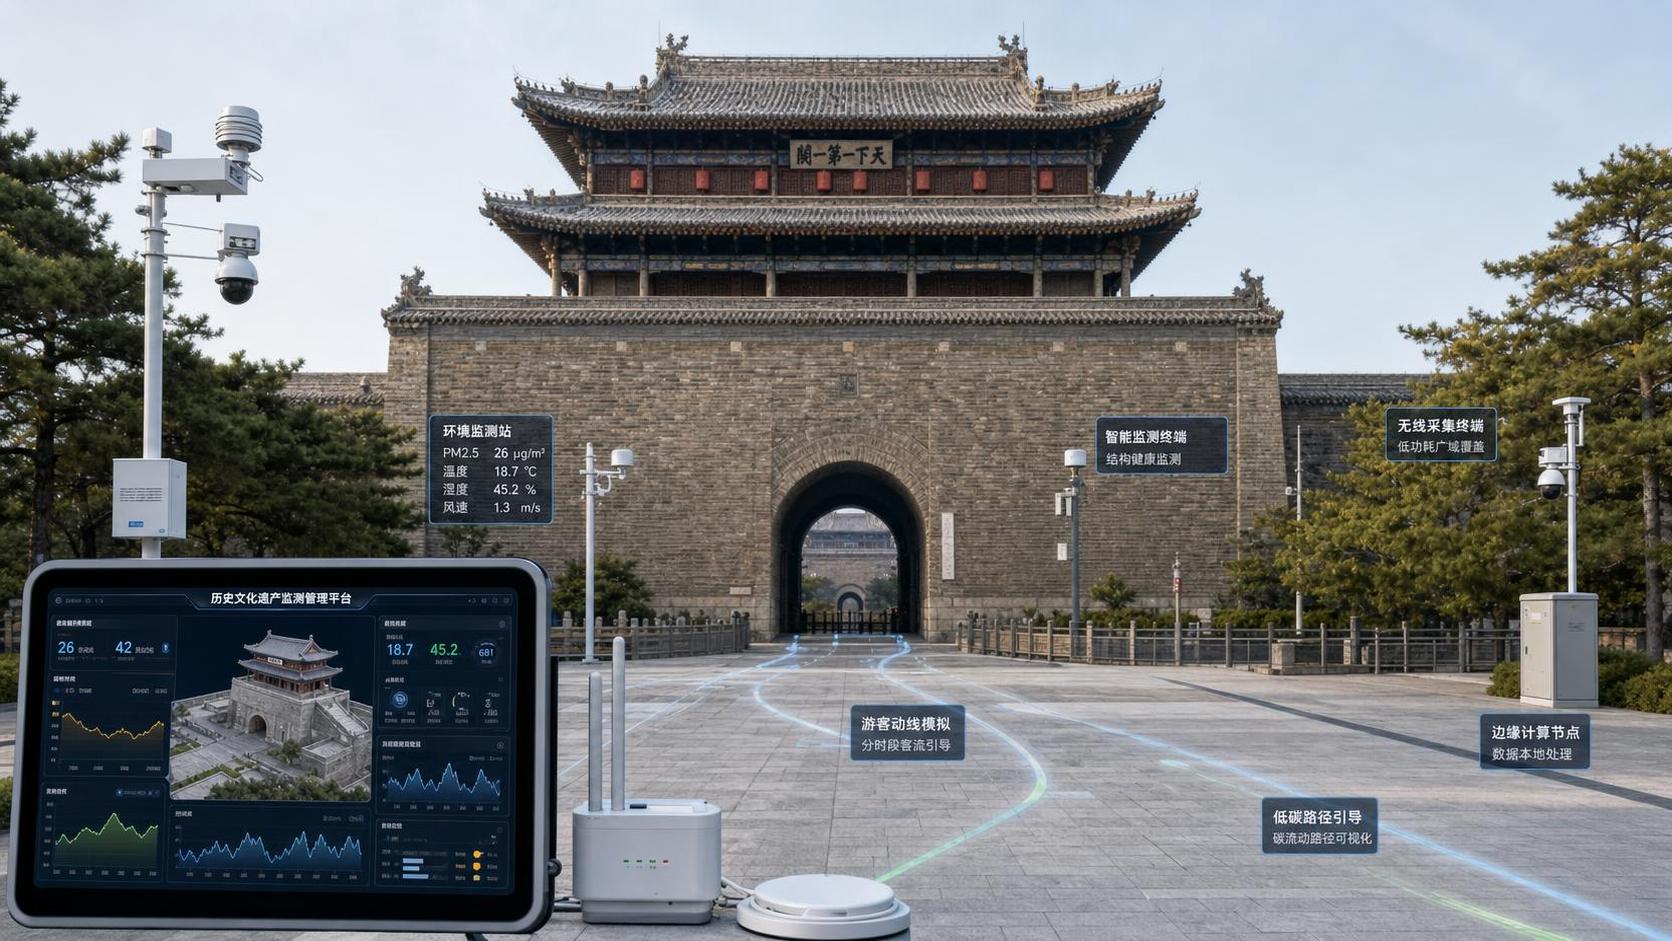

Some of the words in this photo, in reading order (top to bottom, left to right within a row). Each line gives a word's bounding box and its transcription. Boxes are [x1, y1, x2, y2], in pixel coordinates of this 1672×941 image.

[211, 592, 352, 605] 历史文化遗产监测管理平台
[58, 641, 75, 654] 26
[115, 641, 132, 654] 42
[387, 643, 414, 656] 18.7
[430, 643, 458, 656] 45.2
